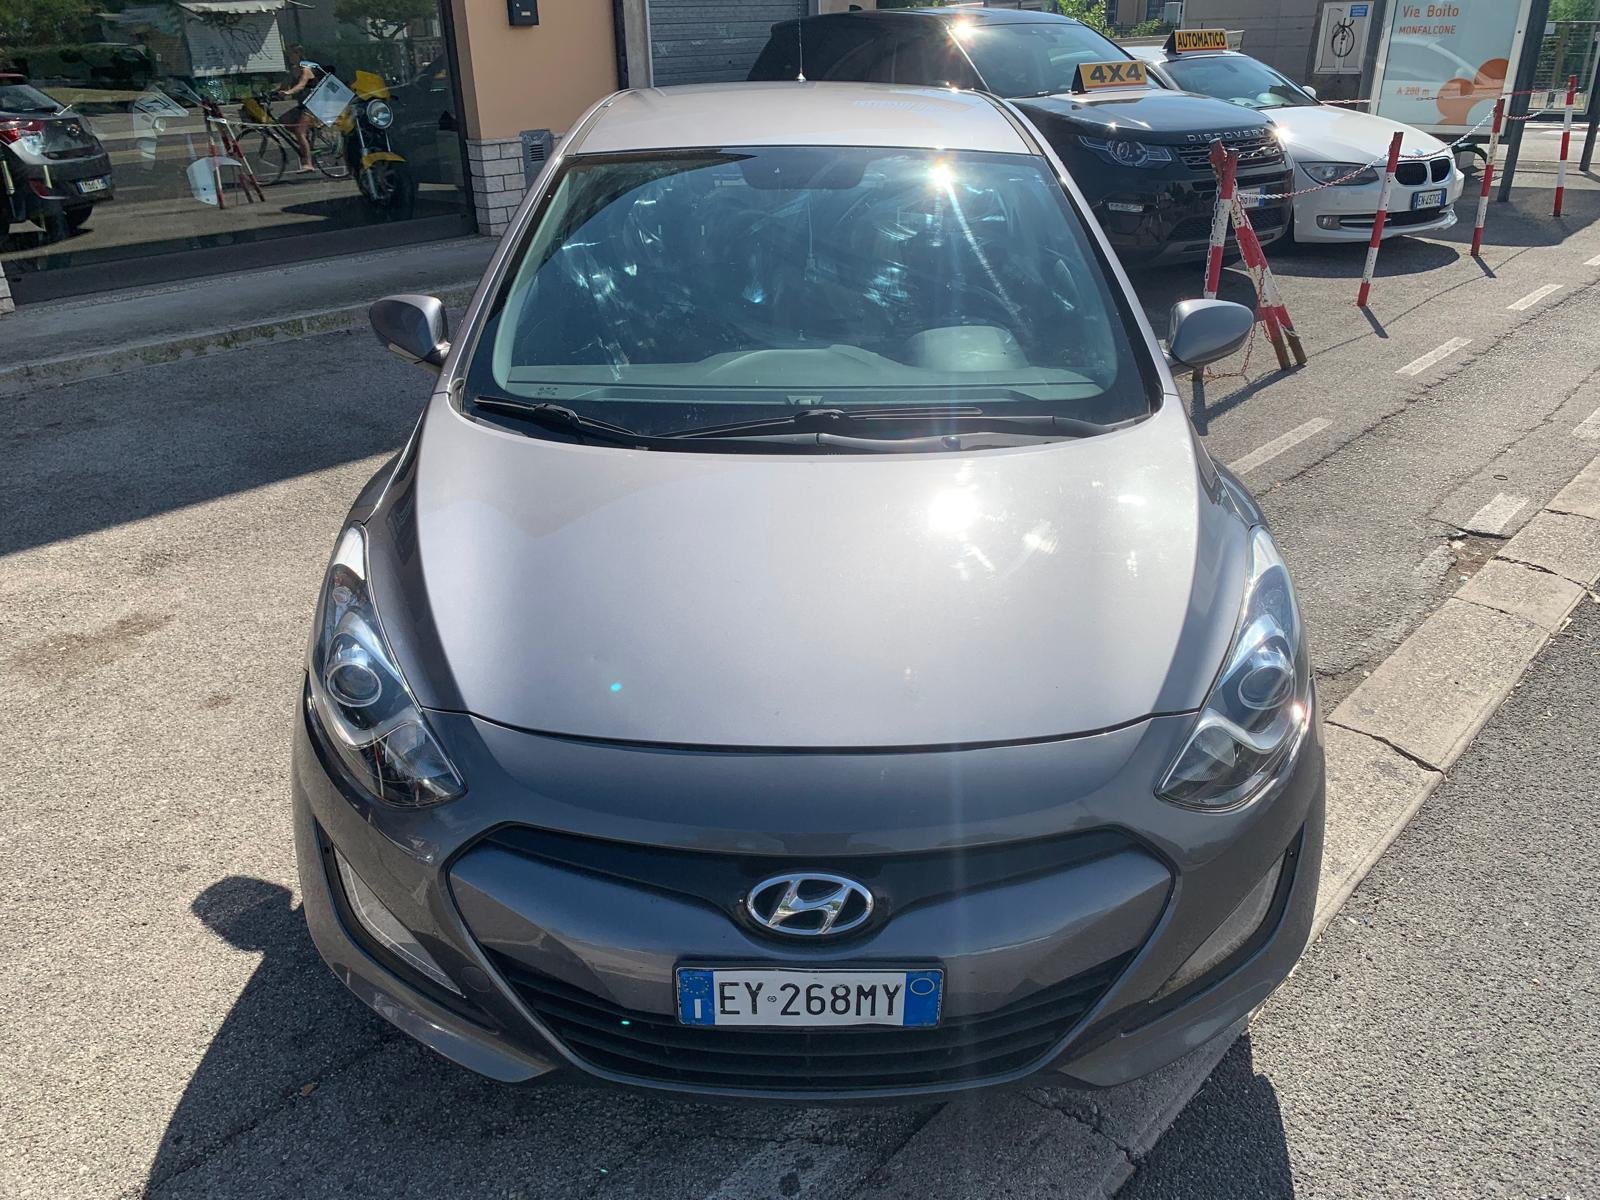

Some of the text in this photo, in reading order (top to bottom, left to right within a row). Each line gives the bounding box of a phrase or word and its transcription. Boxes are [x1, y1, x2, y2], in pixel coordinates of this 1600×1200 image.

[1402, 4, 1460, 18] Via Boito
[1398, 24, 1457, 35] MONFALCONE
[1177, 31, 1226, 49] AUTOMATICO
[1089, 63, 1142, 83] 4X4
[1186, 128, 1266, 143] DISCOVERY
[719, 982, 764, 1015] EY
[780, 982, 903, 1017] 268MY
